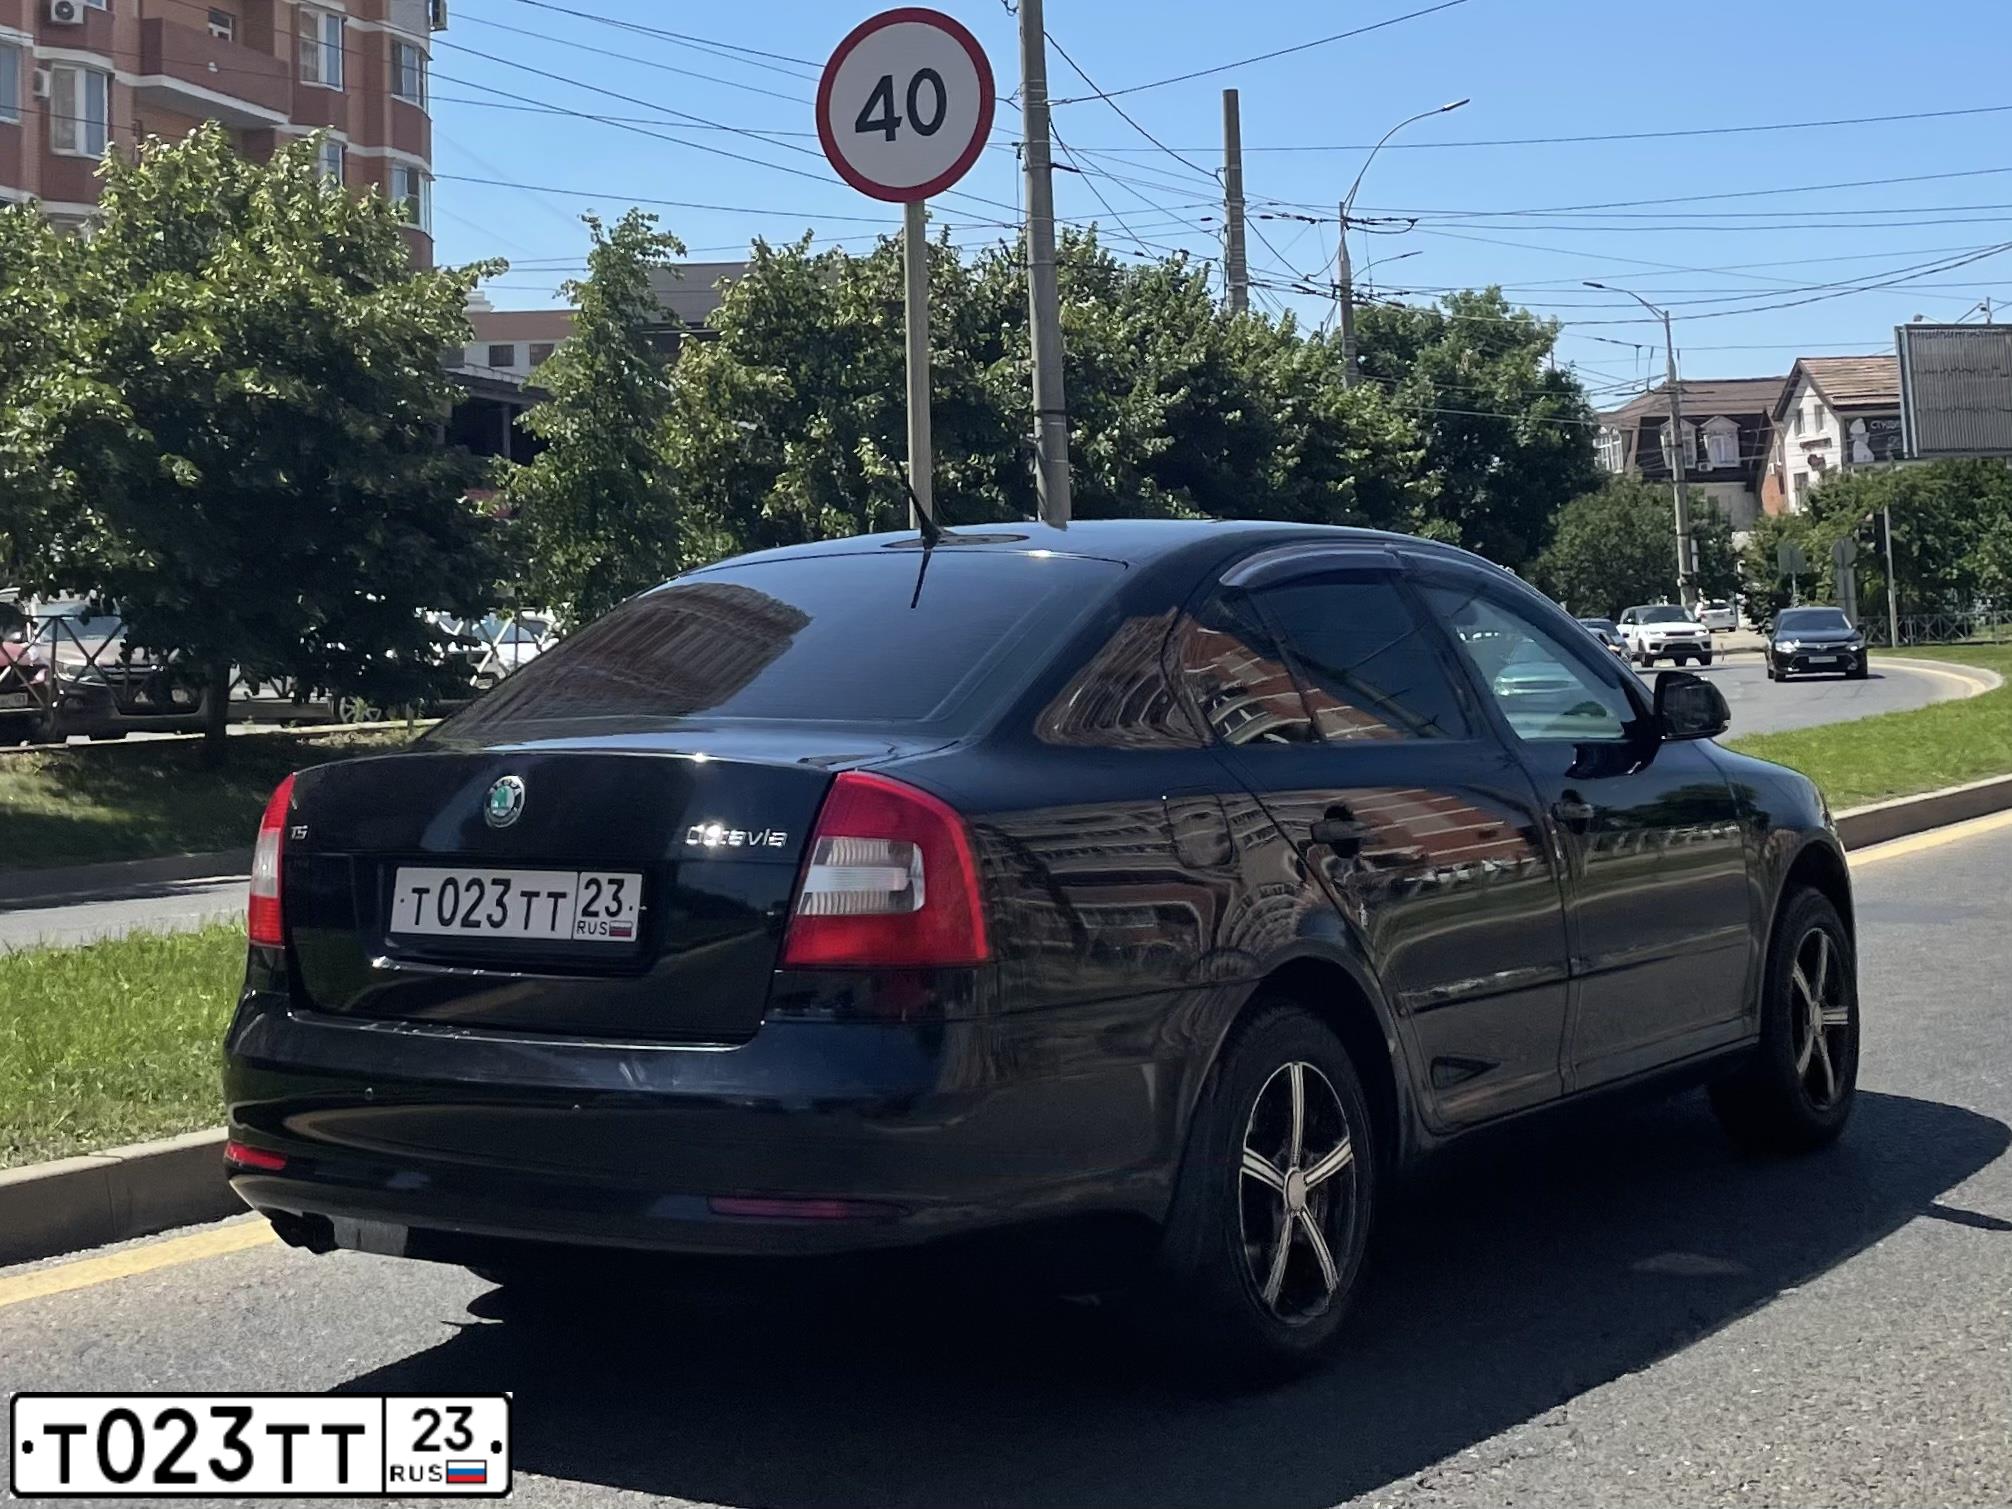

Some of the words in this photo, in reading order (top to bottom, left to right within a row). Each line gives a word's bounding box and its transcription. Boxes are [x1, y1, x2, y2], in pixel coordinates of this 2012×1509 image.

[855, 67, 947, 142] 40
[581, 878, 625, 918] 23
[576, 920, 608, 936] RUS
